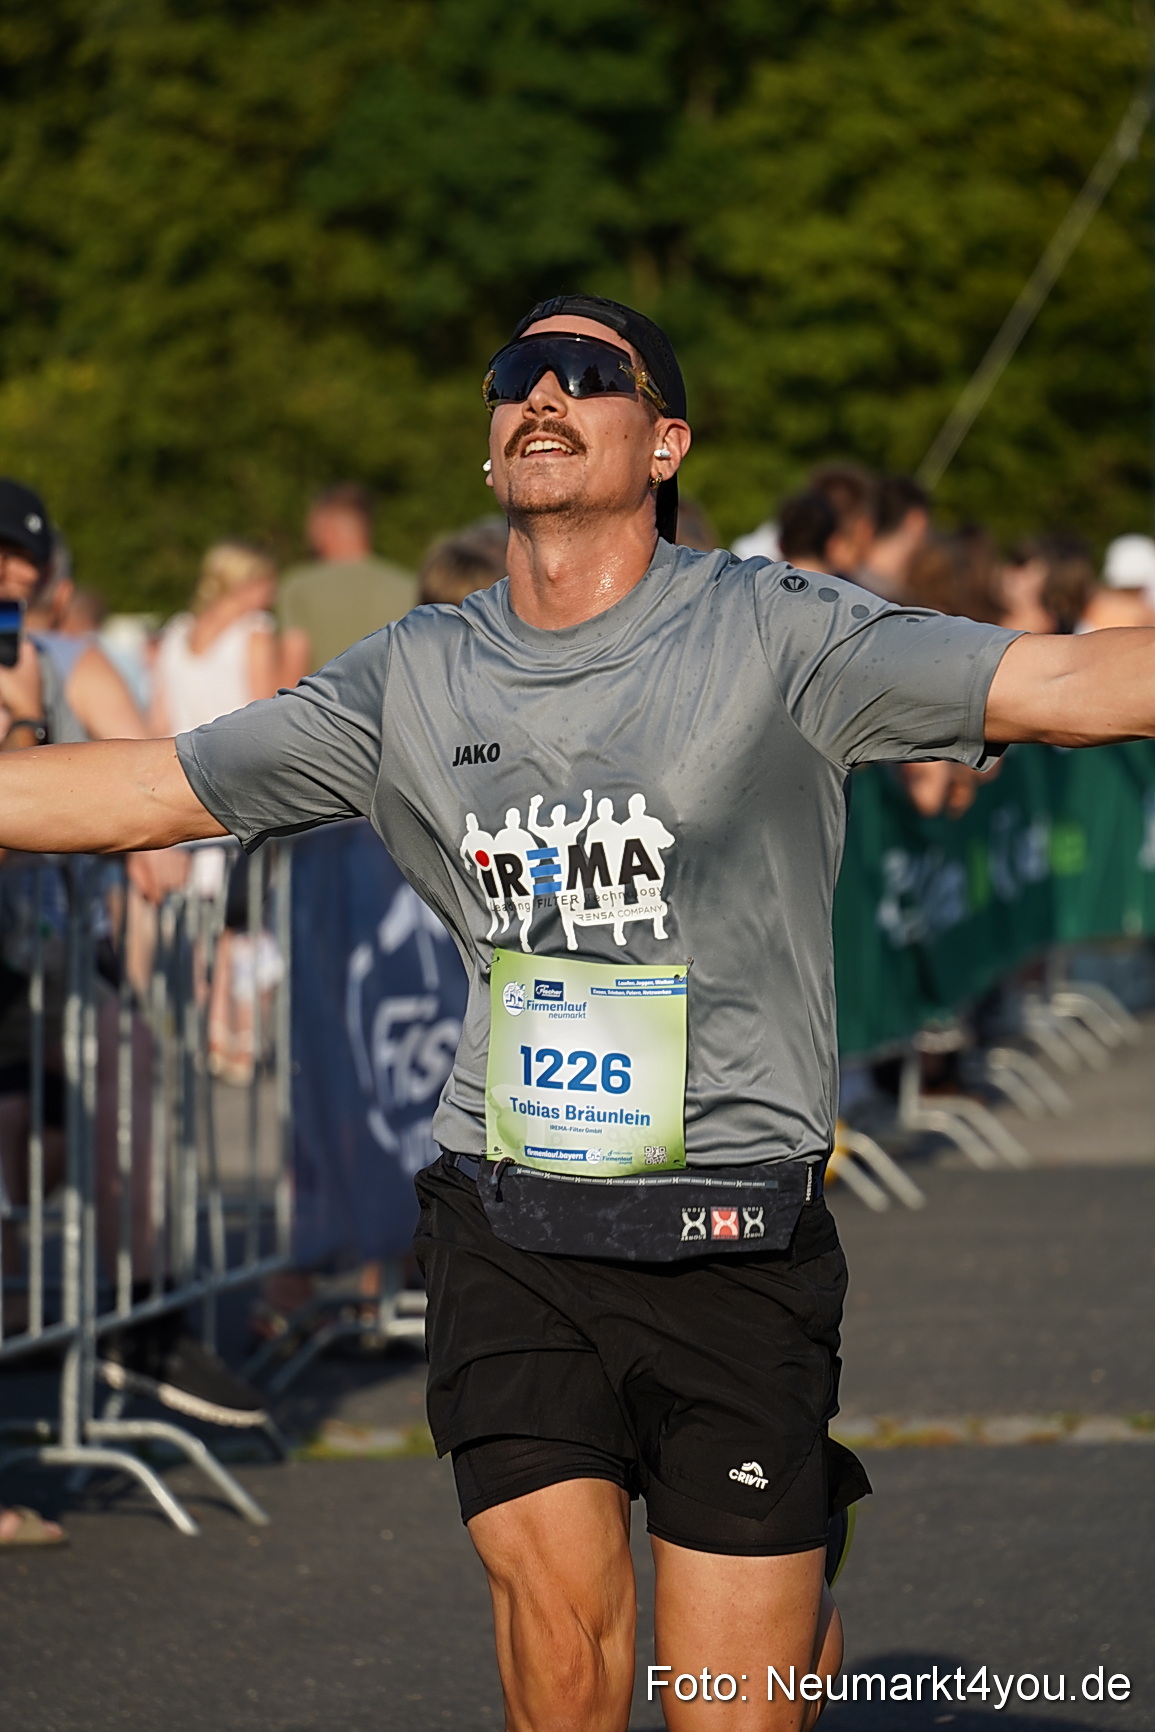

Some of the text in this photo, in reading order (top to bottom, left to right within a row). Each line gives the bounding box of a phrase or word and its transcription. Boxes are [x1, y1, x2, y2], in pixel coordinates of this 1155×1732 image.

[452, 742, 501, 767] JAKO
[490, 901, 531, 913] Leading
[537, 894, 580, 909] FILTER
[617, 905, 664, 918] COMPANY
[526, 1000, 587, 1012] Firmenlauf
[520, 1045, 632, 1095] 1226
[509, 1097, 651, 1127] Tobias Bräunlein
[550, 1125, 584, 1133] IREMA-Filter
[526, 1147, 584, 1161] firmenlauf.bayern
[728, 1468, 769, 1490] CRIVIT
